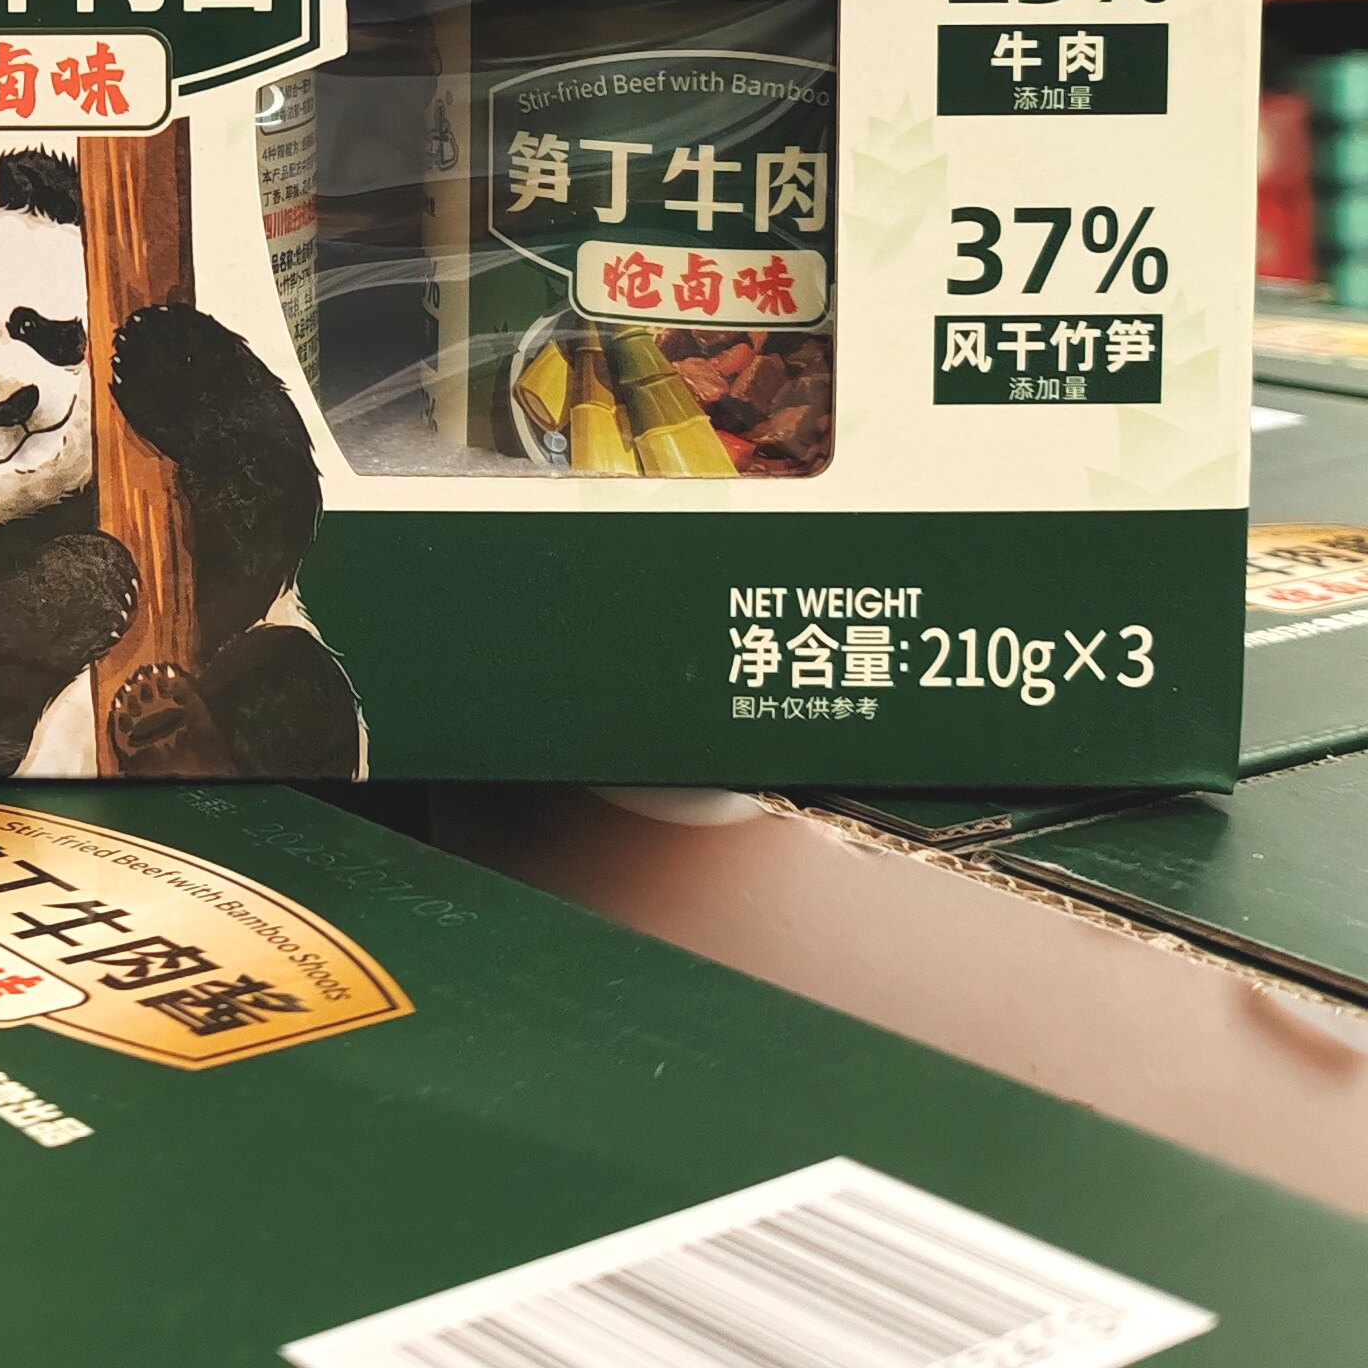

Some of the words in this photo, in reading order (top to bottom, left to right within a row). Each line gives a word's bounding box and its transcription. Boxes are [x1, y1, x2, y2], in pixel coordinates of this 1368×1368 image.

[990, 30, 1105, 83] 牛肉
[517, 78, 609, 115] Stir-fried
[613, 71, 667, 95] Beef
[668, 70, 725, 94] with
[731, 73, 831, 108] Bamboo
[1012, 85, 1094, 111] 添加量
[506, 130, 829, 233] 笋丁牛肉
[945, 205, 1170, 296] 37%
[602, 251, 799, 317] 炝卤味
[940, 319, 1157, 374] 风干竹笋
[1007, 376, 1089, 402] 添加量
[729, 587, 789, 619] NET
[796, 587, 924, 619] WEIGHT
[731, 695, 880, 721] 图片仅供参考
[111, 853, 173, 879] Beef
[165, 870, 226, 905] with
[213, 900, 301, 955] Bamboo
[289, 952, 353, 1004] Shoots
